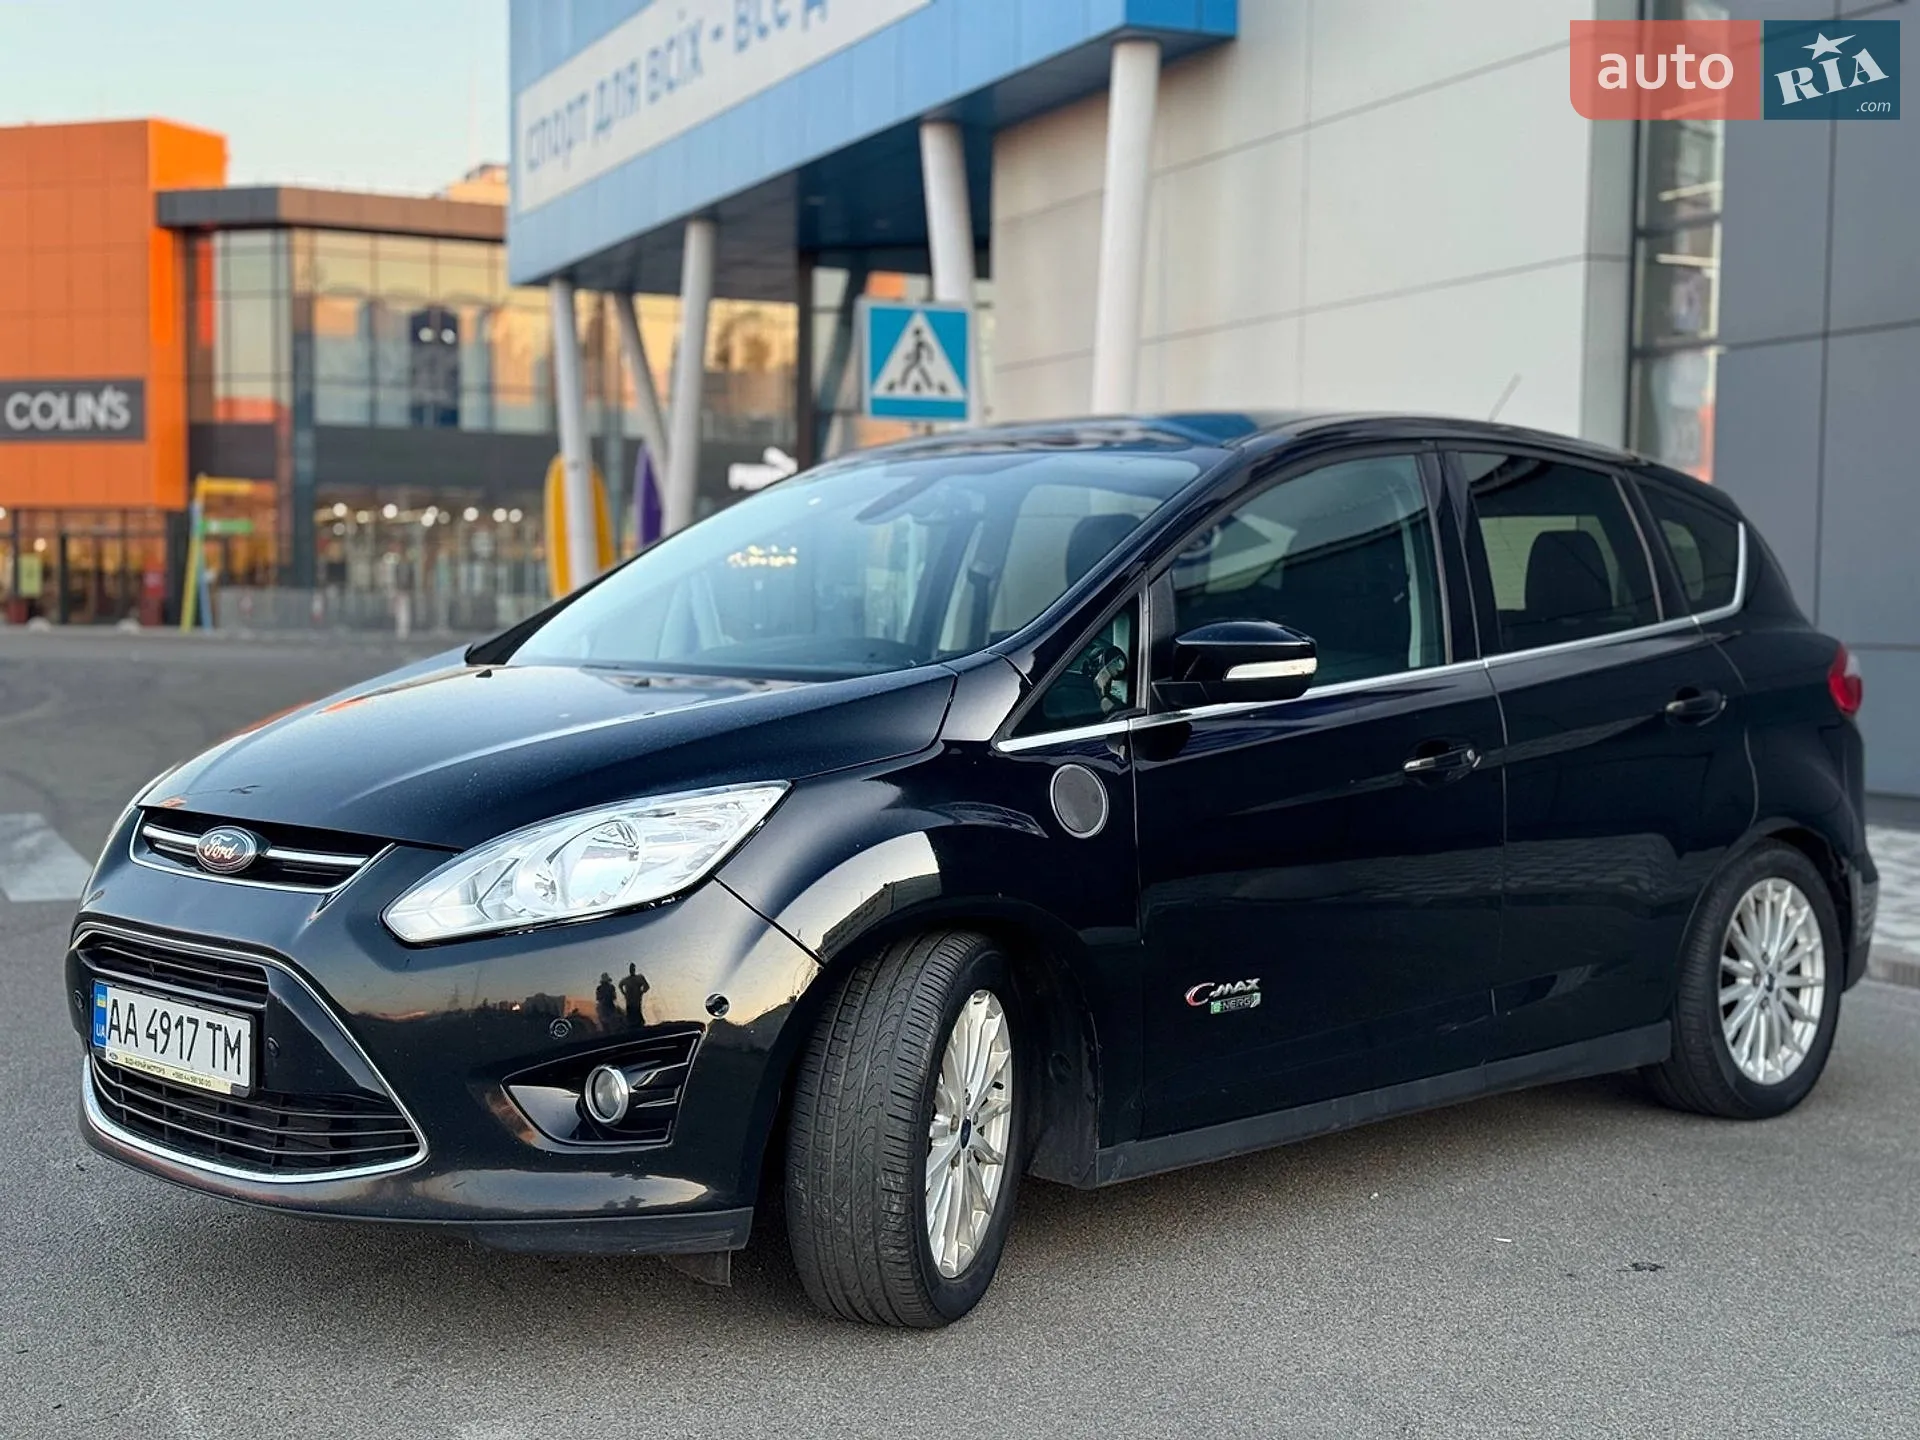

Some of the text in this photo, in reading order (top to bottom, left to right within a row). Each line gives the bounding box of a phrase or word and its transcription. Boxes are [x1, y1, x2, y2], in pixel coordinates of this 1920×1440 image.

[204, 834, 239, 860] Ford
[108, 998, 242, 1076] AA 4917 TM
